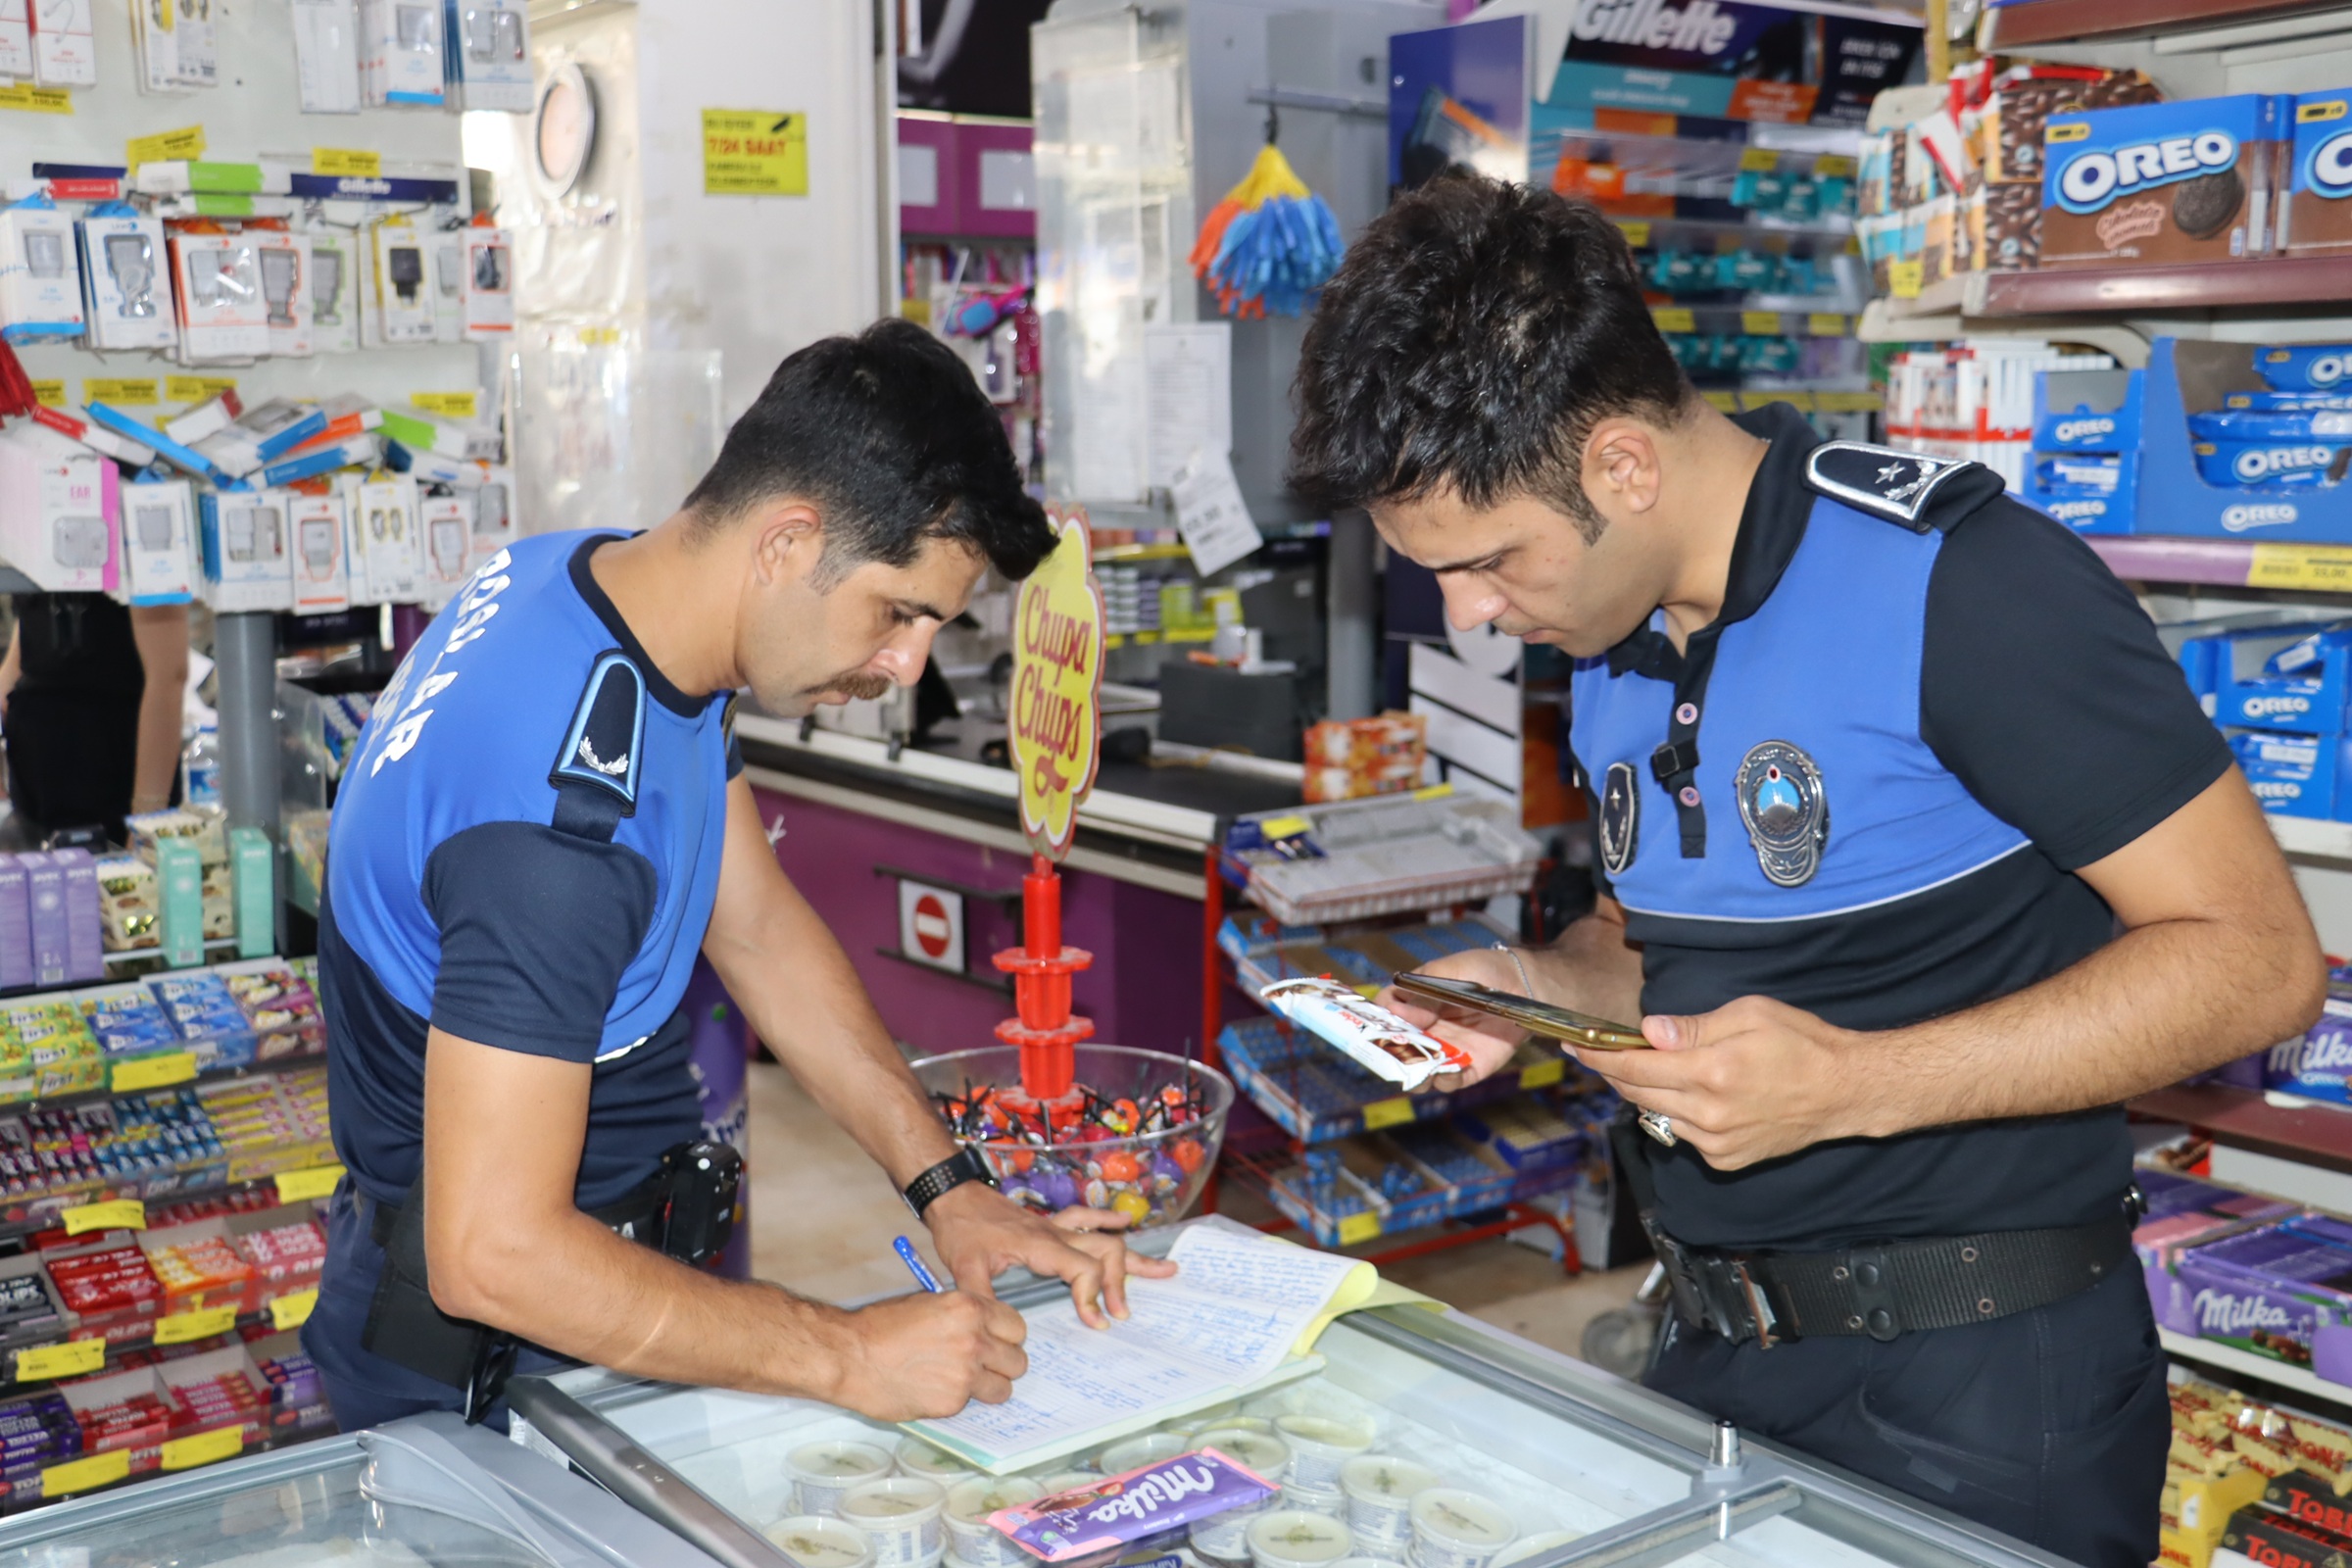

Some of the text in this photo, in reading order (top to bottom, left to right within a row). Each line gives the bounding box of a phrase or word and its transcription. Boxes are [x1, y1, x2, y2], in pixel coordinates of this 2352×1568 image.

[1572, 0, 1736, 54] Gillette
[2061, 132, 2234, 203] OREO
[2055, 417, 2115, 442] OREO
[2237, 445, 2333, 478] OREO
[2224, 504, 2297, 530] OREO
[1025, 583, 1093, 687] Chupa
[1017, 662, 1084, 764] Chups
[2242, 697, 2311, 718] OREO
[2250, 782, 2301, 800] REO
[2267, 1031, 2352, 1078] Milk
[2193, 1288, 2293, 1334] Milka
[1088, 1464, 1215, 1523] Milka
